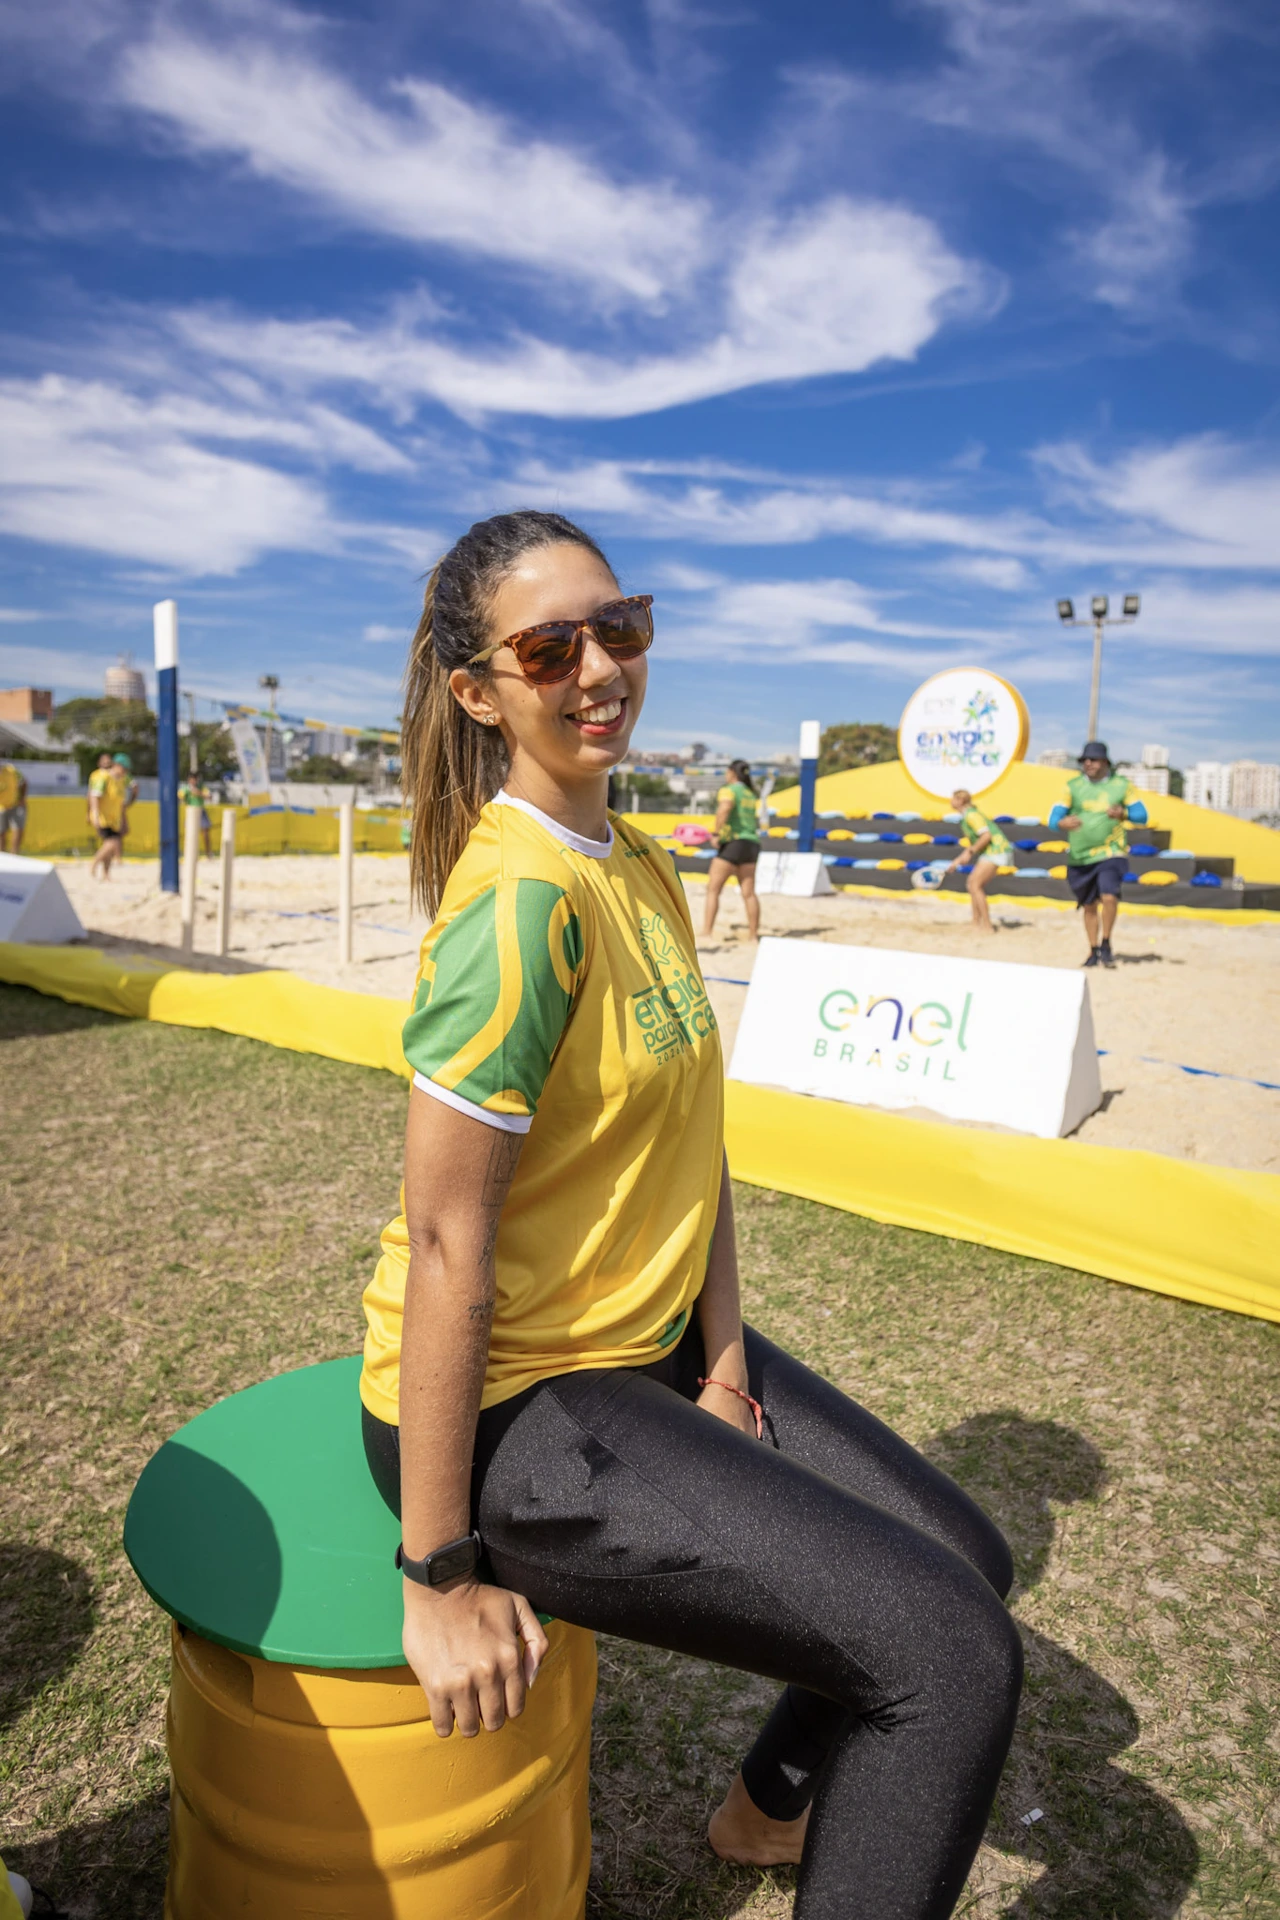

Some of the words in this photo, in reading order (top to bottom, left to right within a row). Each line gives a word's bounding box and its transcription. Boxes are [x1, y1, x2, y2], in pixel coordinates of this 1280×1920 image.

[642, 1020, 676, 1054] para
[819, 989, 972, 1052] enel
[813, 1038, 956, 1081] BRASIL
